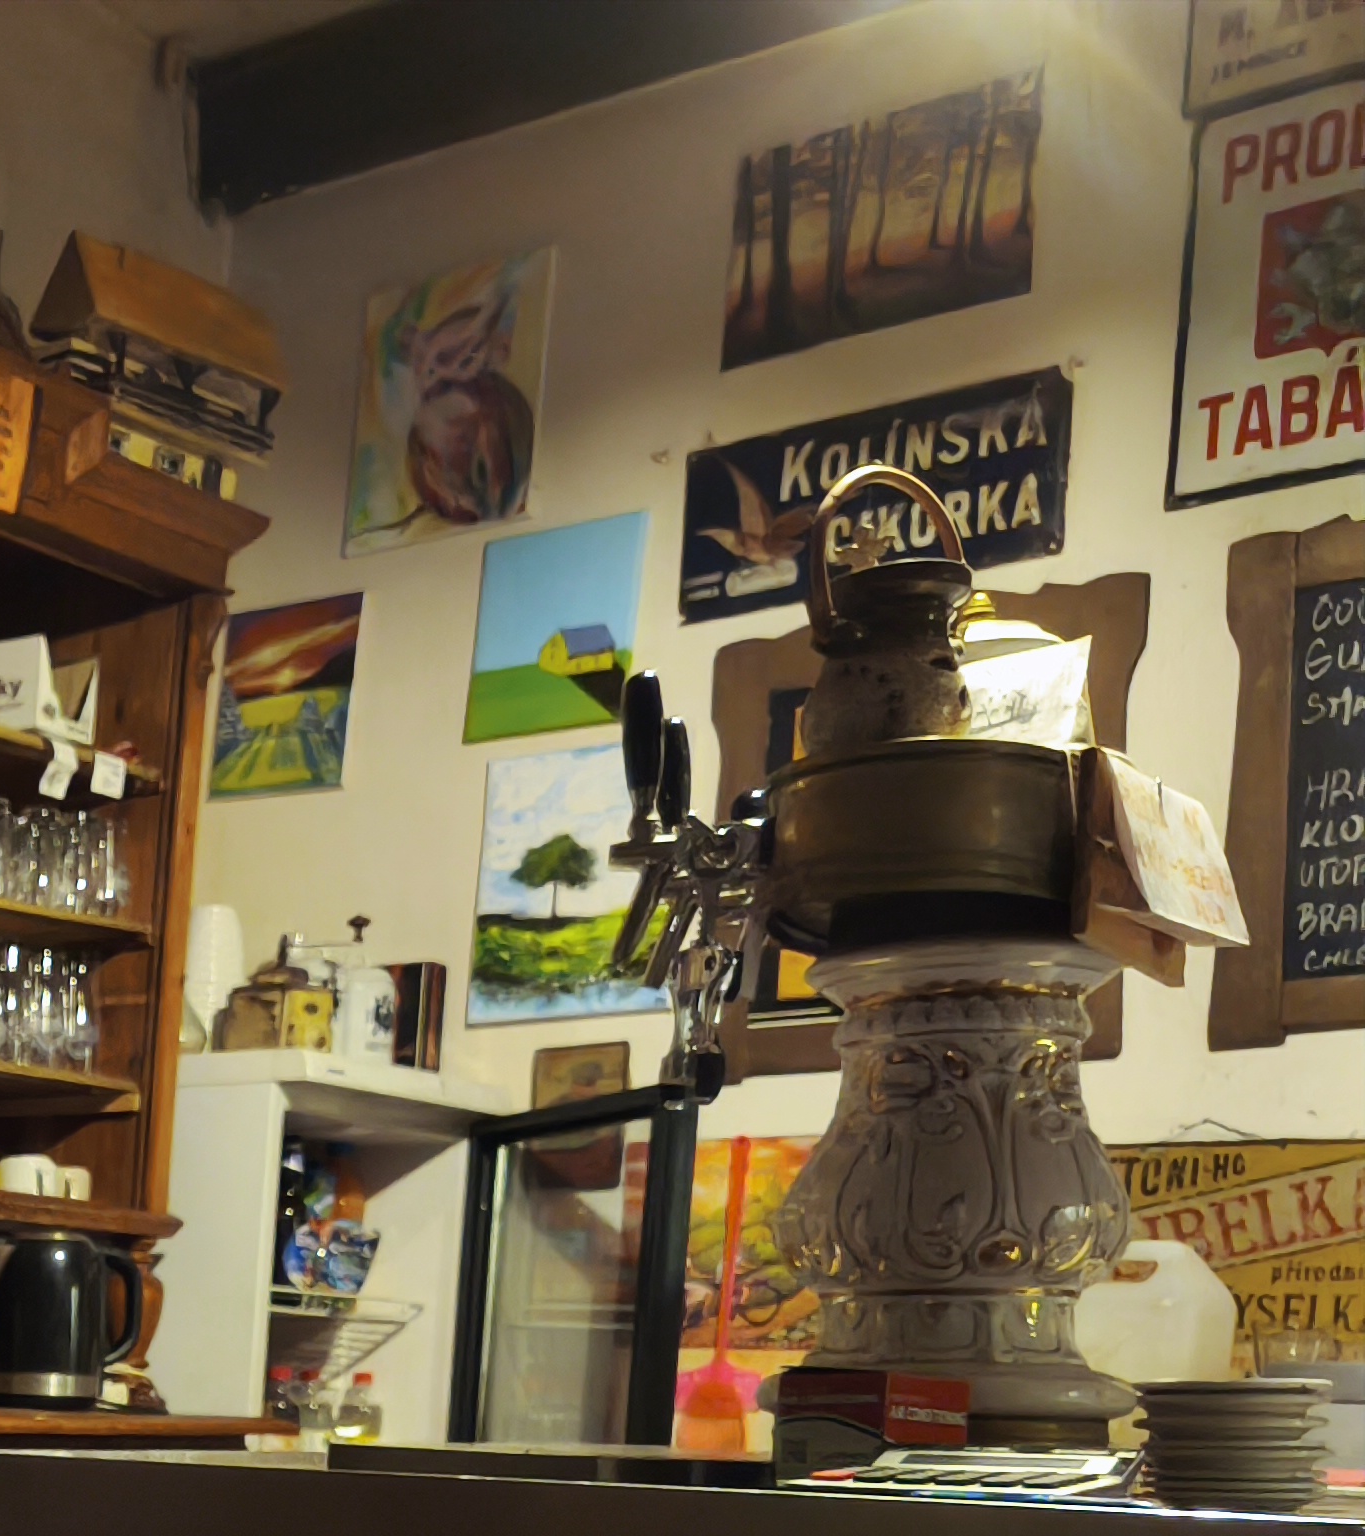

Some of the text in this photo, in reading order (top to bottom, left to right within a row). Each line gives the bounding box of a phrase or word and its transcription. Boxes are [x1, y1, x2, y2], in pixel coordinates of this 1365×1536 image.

[1198, 346, 1365, 461] TABÁ
[1305, 637, 1365, 681] GU
[1229, 1285, 1365, 1333] YSELK
